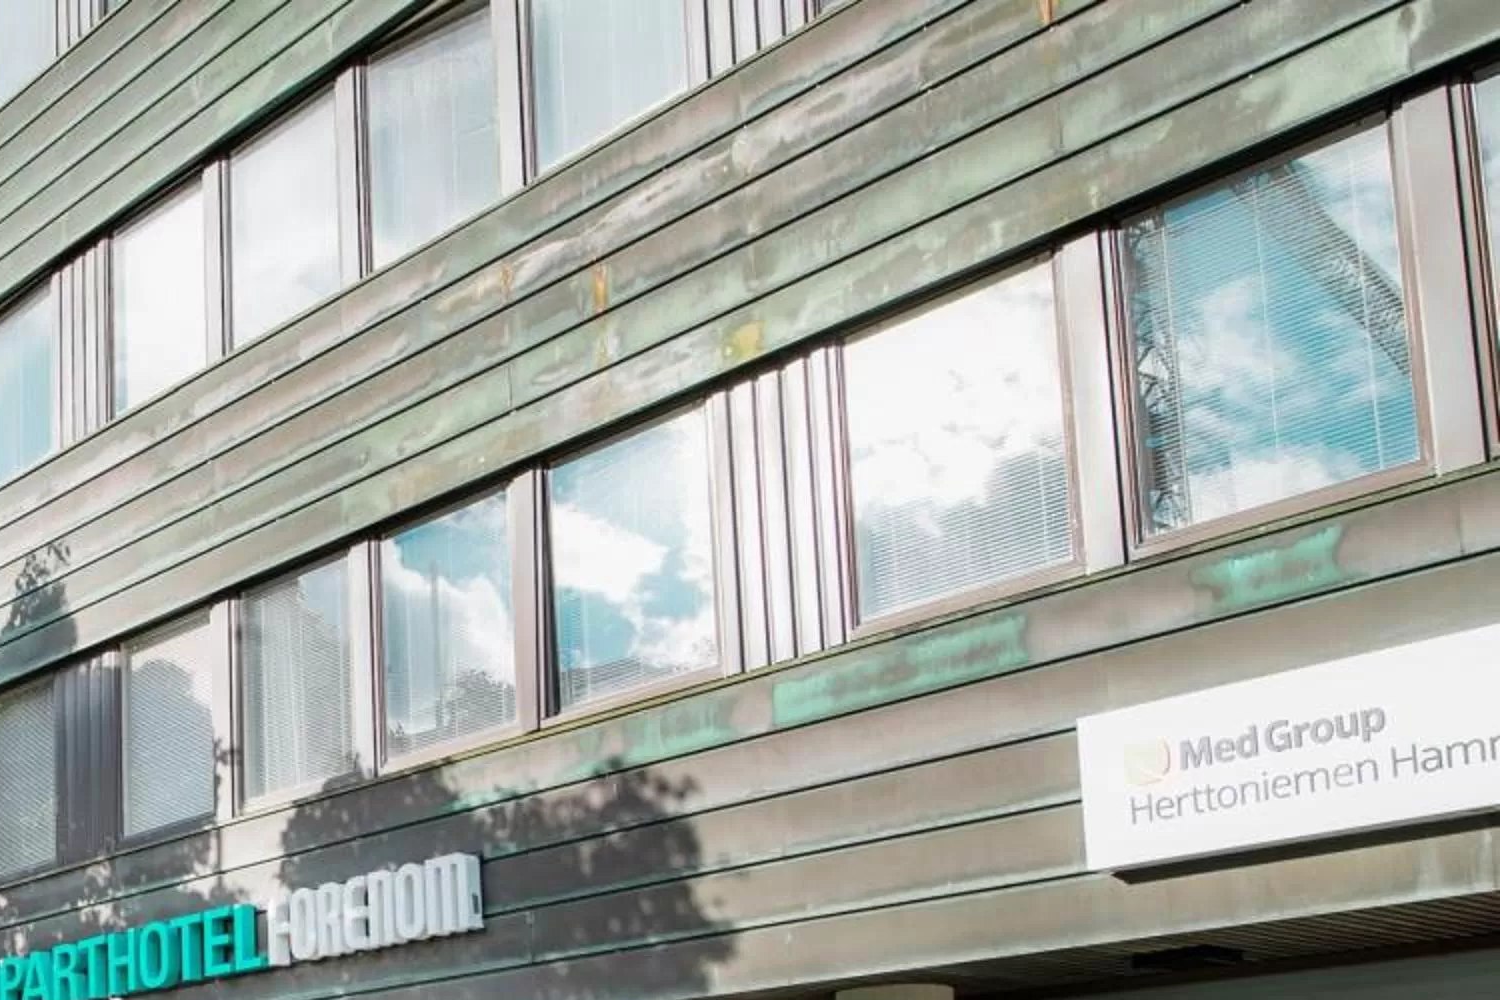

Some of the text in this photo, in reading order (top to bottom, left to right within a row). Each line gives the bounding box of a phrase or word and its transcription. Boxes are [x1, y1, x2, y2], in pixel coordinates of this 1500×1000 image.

[1130, 734, 1500, 824] Herttoniemen Ham
[1179, 706, 1386, 770] Med Group
[266, 852, 484, 967] FORENOM
